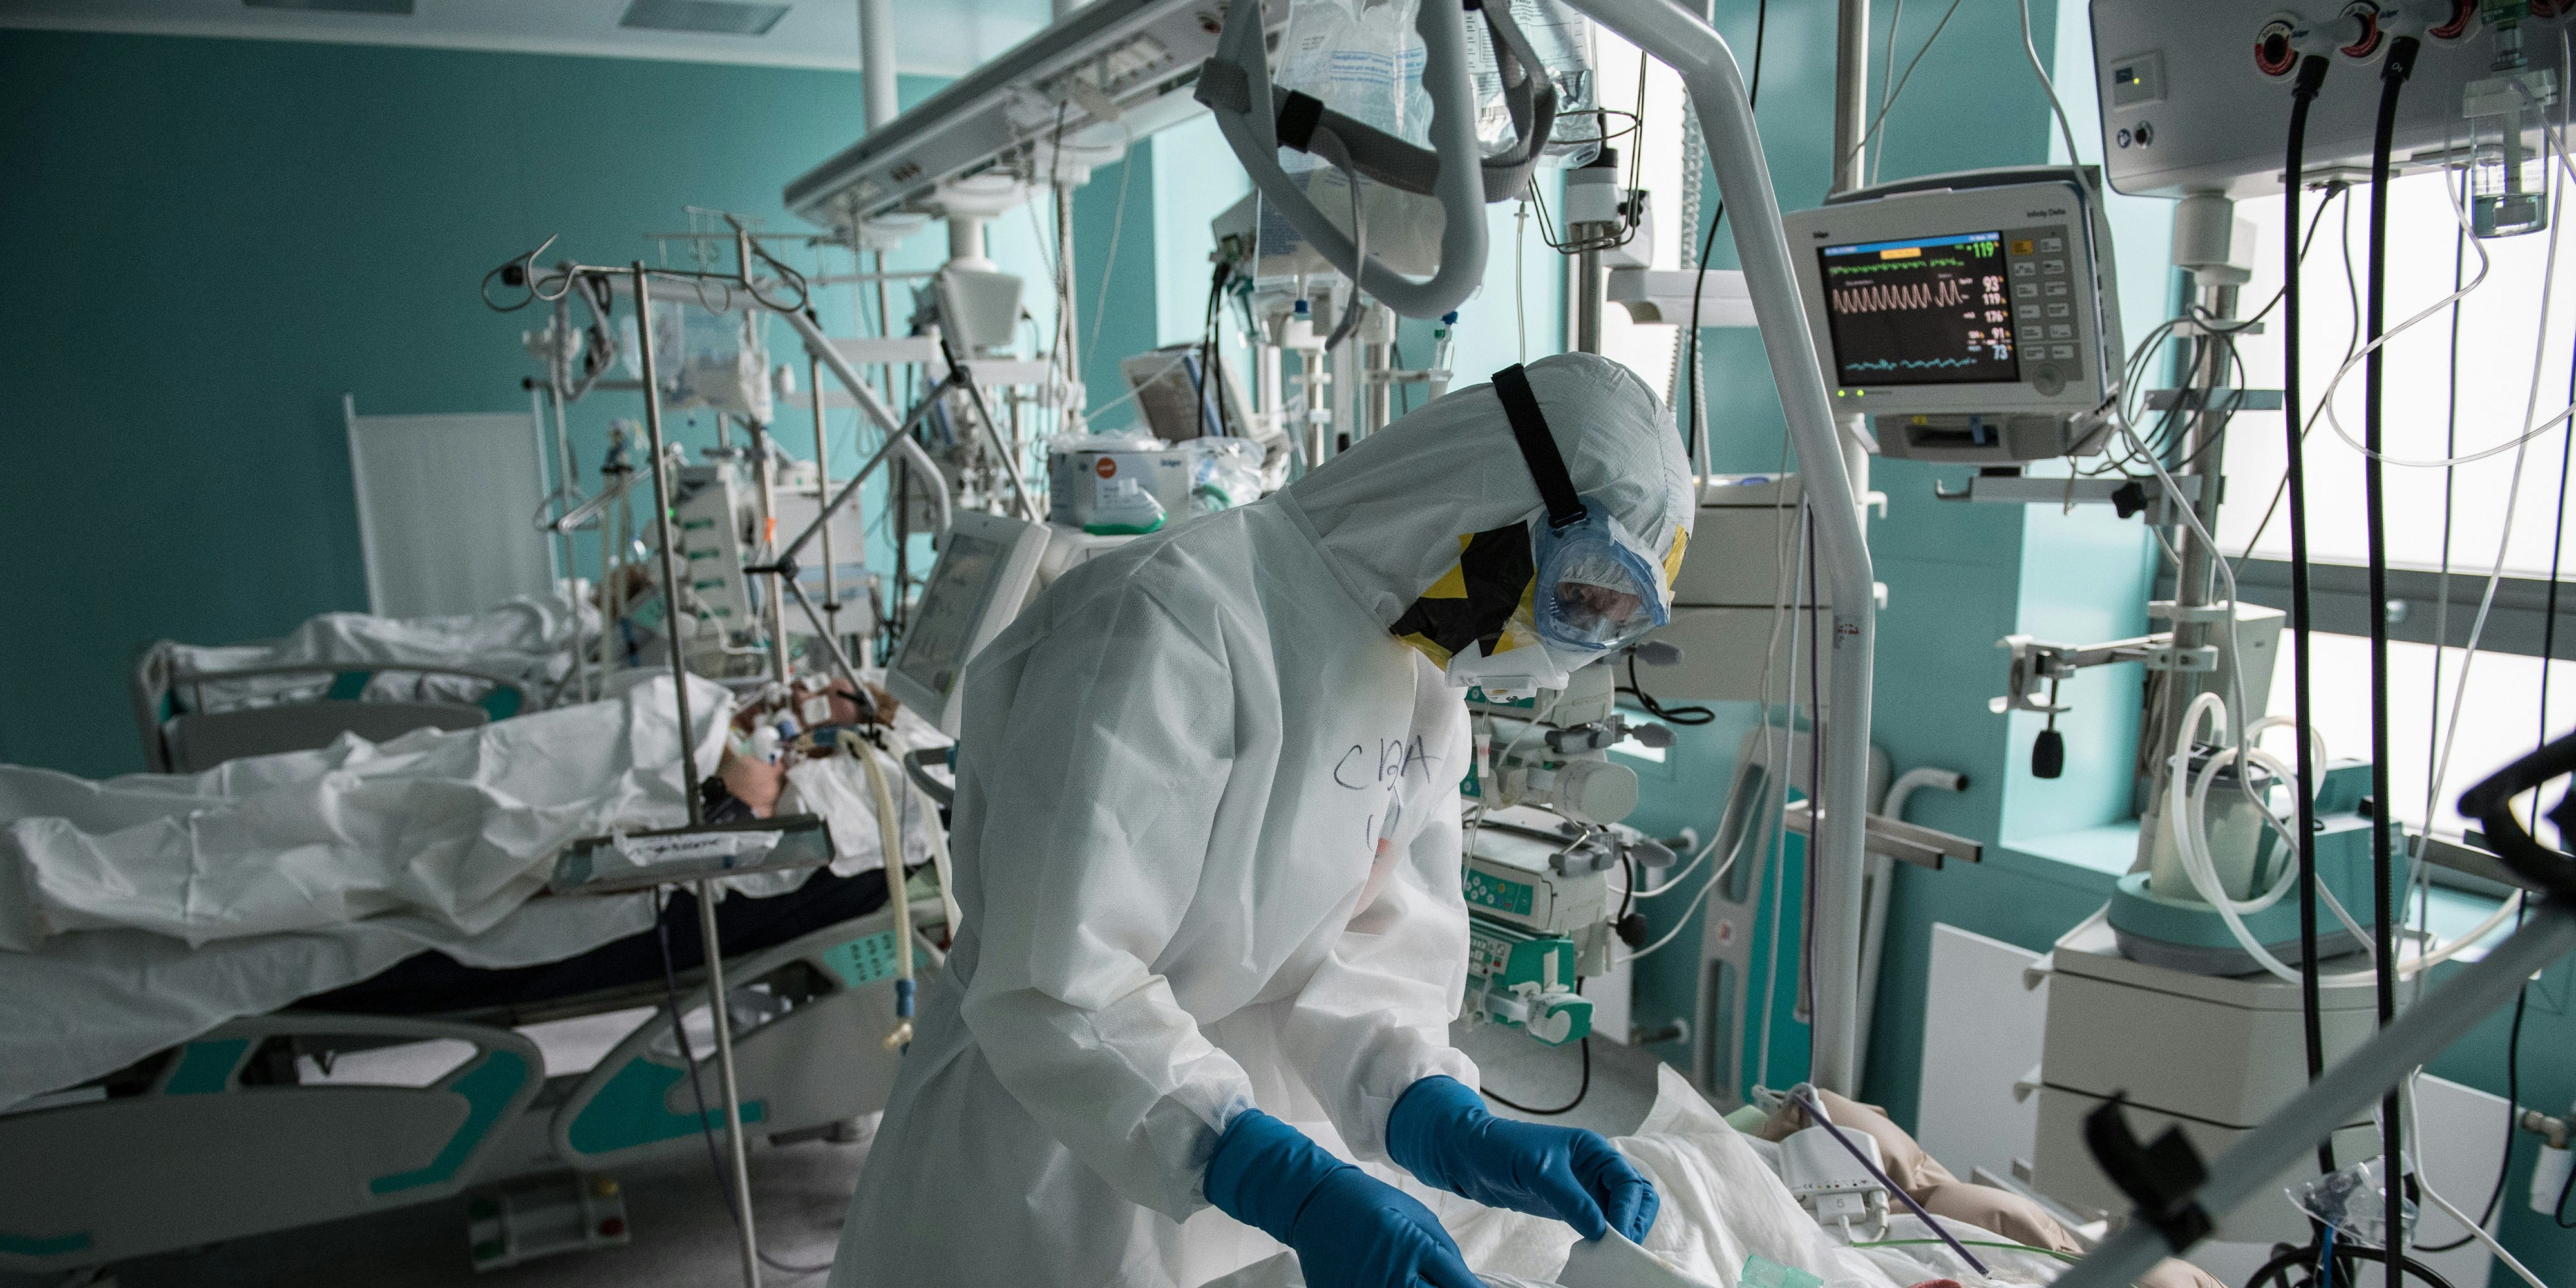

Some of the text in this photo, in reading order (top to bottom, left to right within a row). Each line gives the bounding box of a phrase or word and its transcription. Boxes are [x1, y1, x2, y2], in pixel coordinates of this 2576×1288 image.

[1973, 241, 1994, 258] 119
[1983, 275, 2000, 293] 93
[1985, 310, 2004, 323] 176
[1991, 327, 2005, 340] 91
[1992, 344, 2009, 361] 73
[1836, 1198, 1845, 1208] 5
